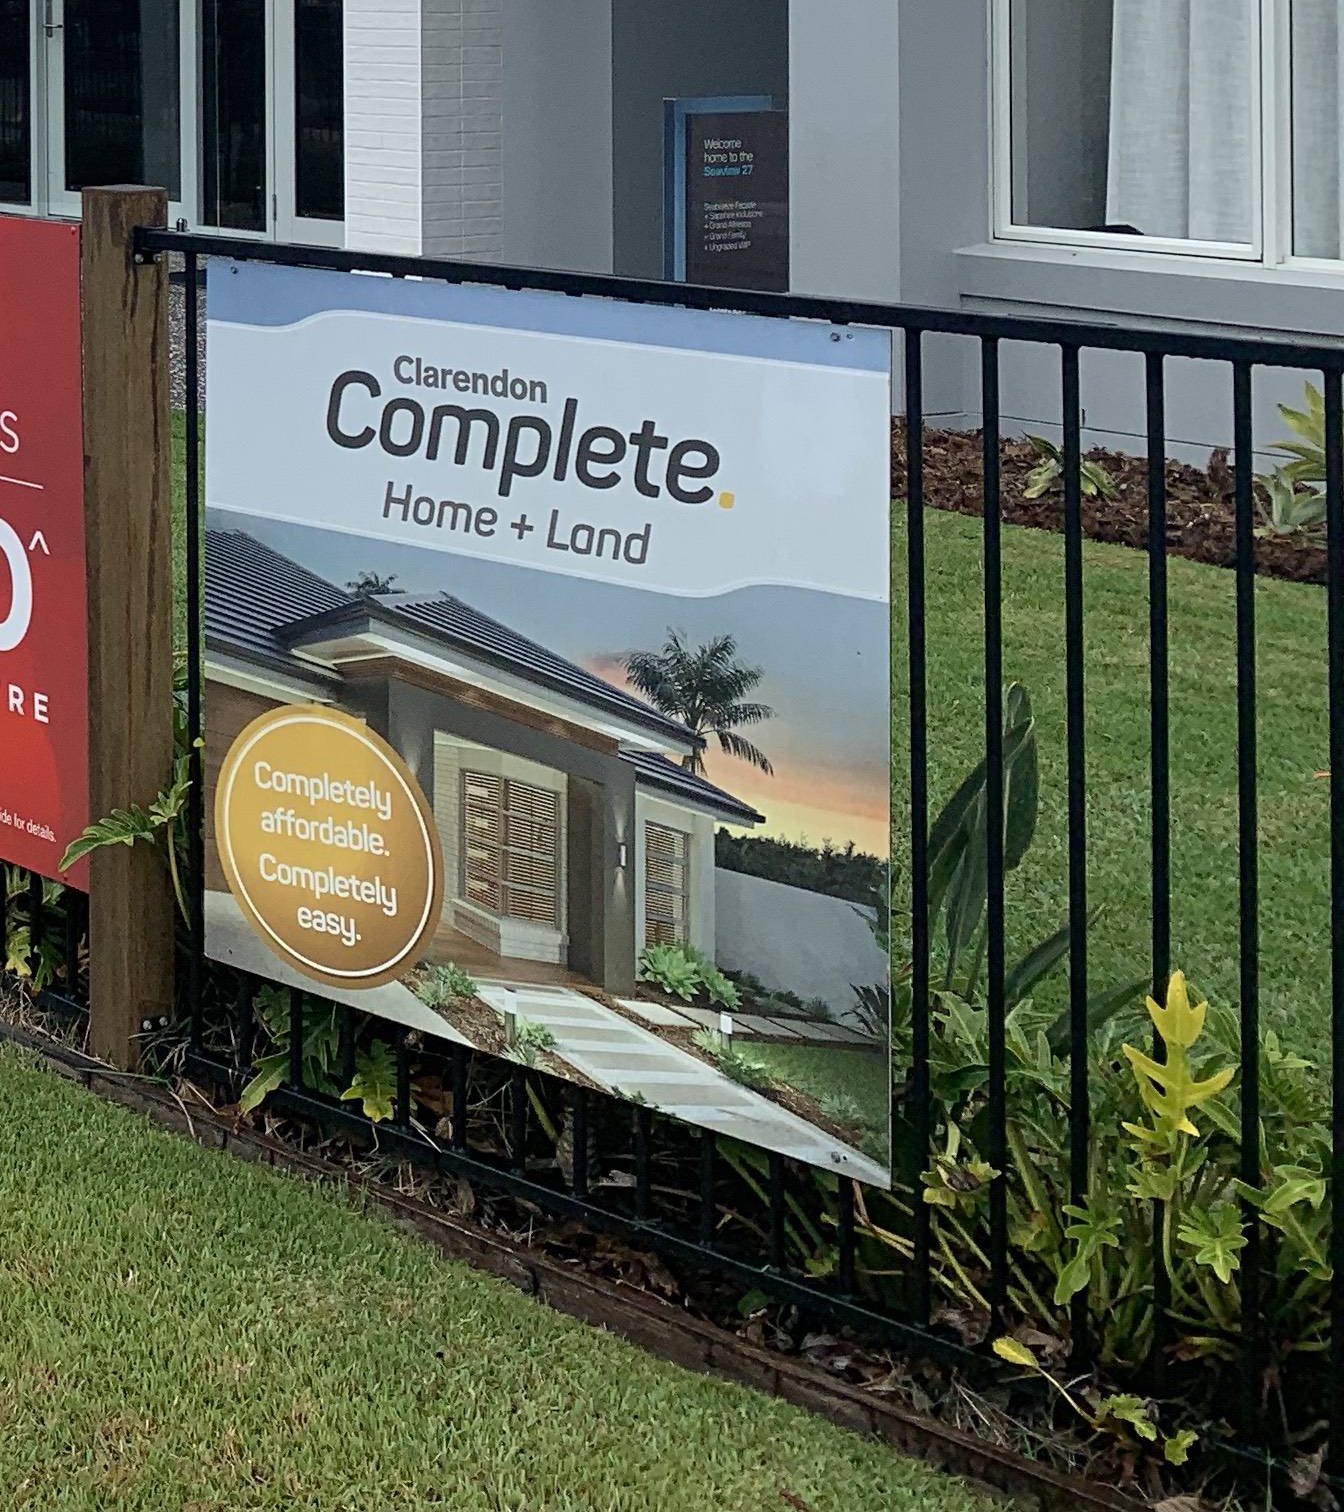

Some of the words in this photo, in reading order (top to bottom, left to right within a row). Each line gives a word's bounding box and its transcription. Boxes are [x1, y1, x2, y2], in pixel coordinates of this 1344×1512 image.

[704, 139, 742, 149] Welcome
[704, 152, 727, 163] home
[729, 152, 738, 162] to
[739, 151, 753, 162] the
[742, 164, 753, 175] 27
[393, 354, 548, 404] Clarendon
[326, 369, 735, 510] Complete.
[382, 481, 498, 538] Home
[510, 513, 534, 540] +
[547, 508, 652, 565] Land
[253, 760, 392, 820] Completely
[14, 812, 25, 830] for
[26, 819, 56, 843] details.
[261, 806, 390, 857] affordable.
[258, 853, 398, 917] Completely
[297, 905, 361, 947] easy.
